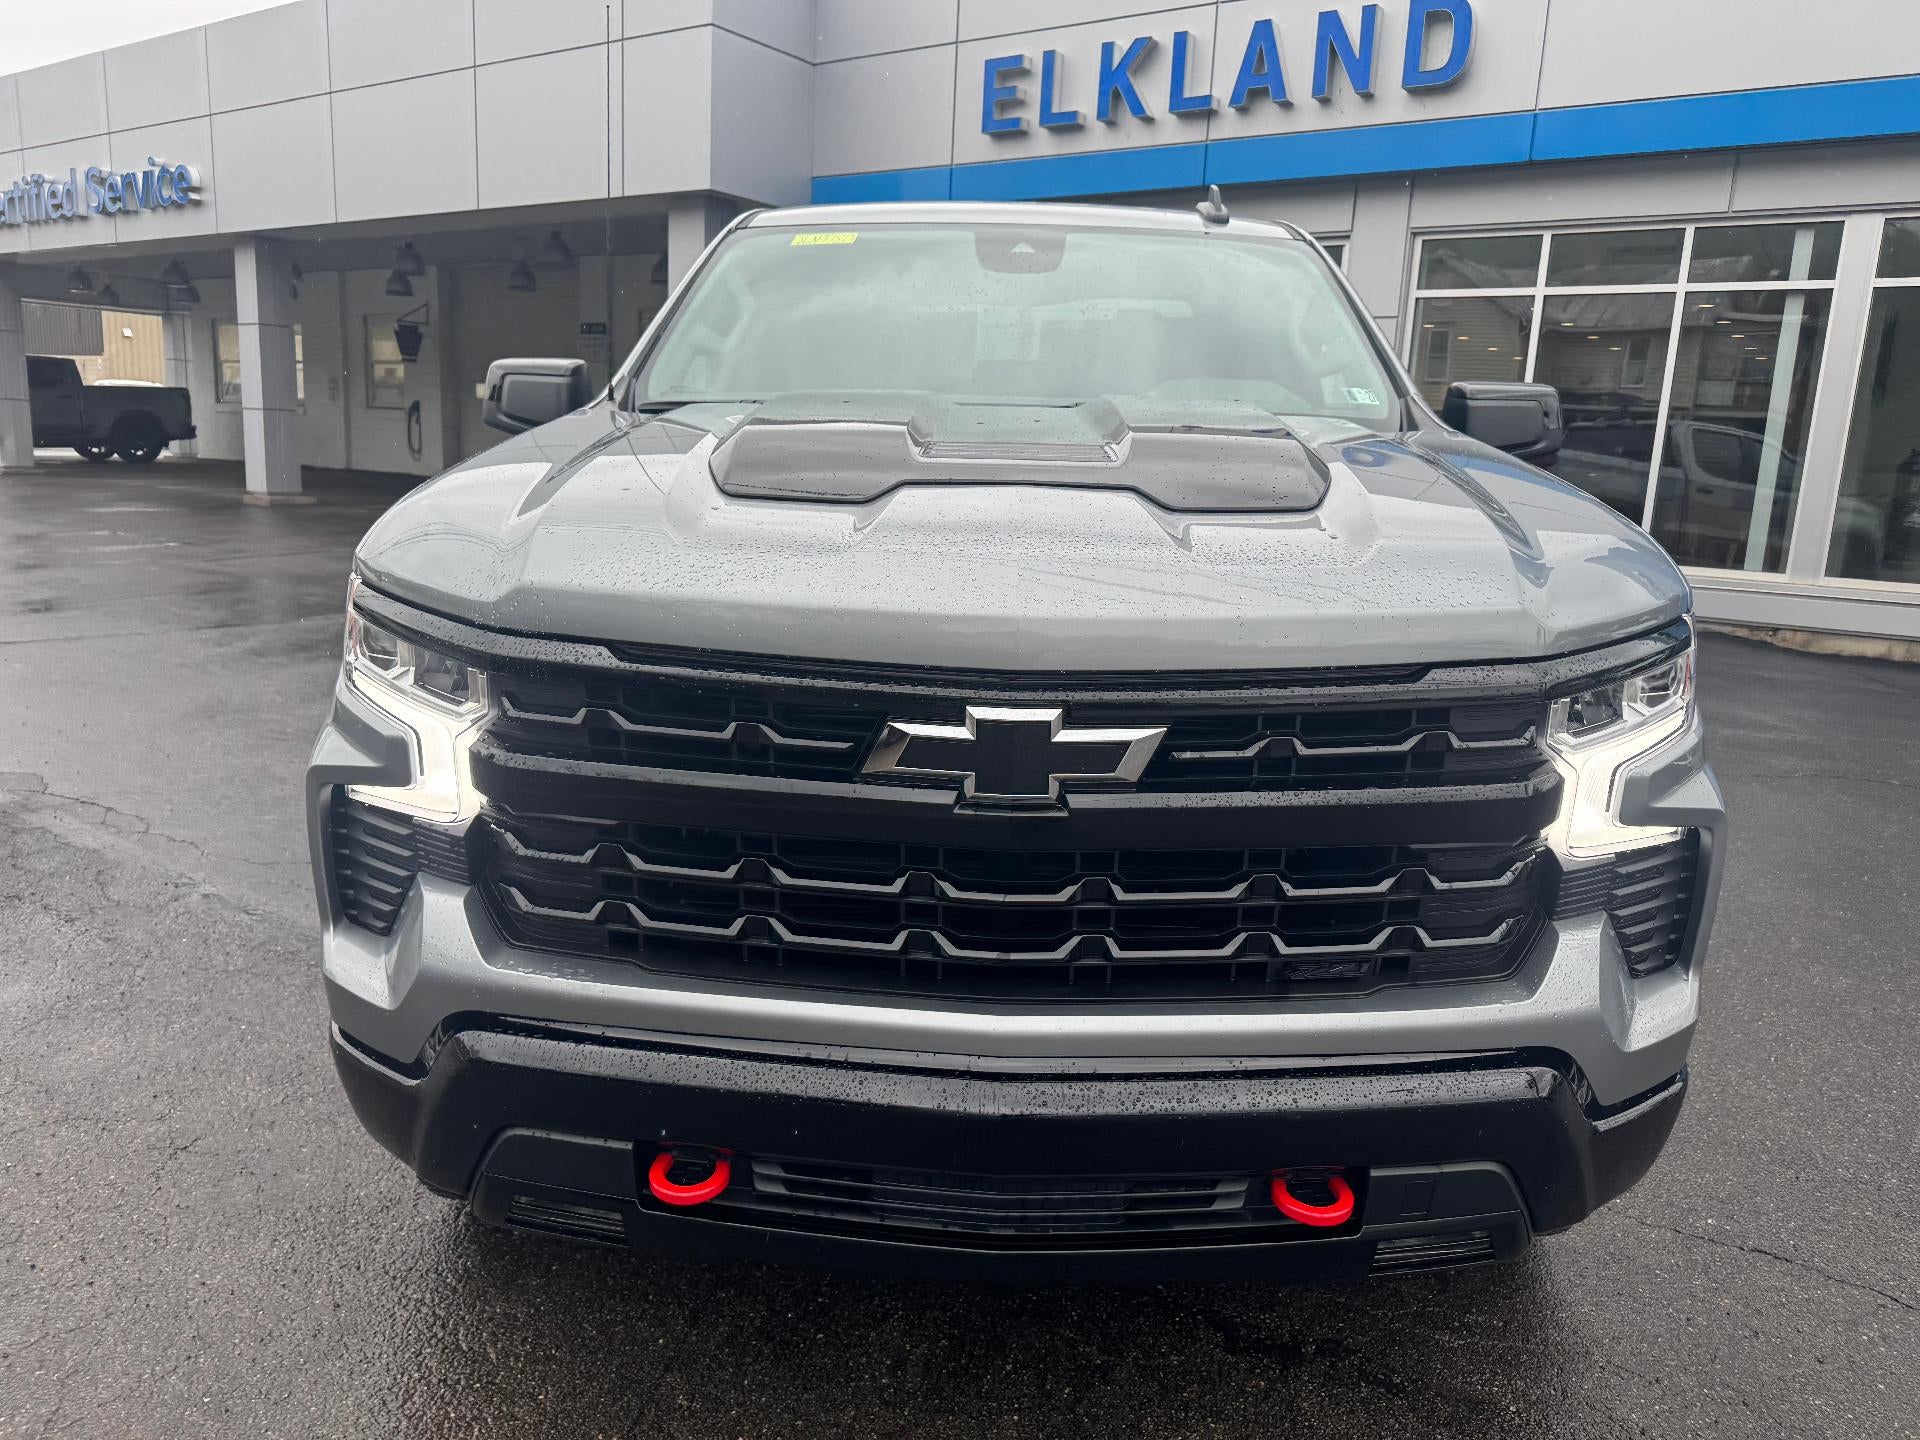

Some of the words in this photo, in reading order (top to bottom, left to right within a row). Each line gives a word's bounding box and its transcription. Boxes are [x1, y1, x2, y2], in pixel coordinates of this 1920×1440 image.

[982, 0, 1474, 134] ELKLAND
[0, 167, 77, 224] rtified
[86, 156, 194, 214] Service
